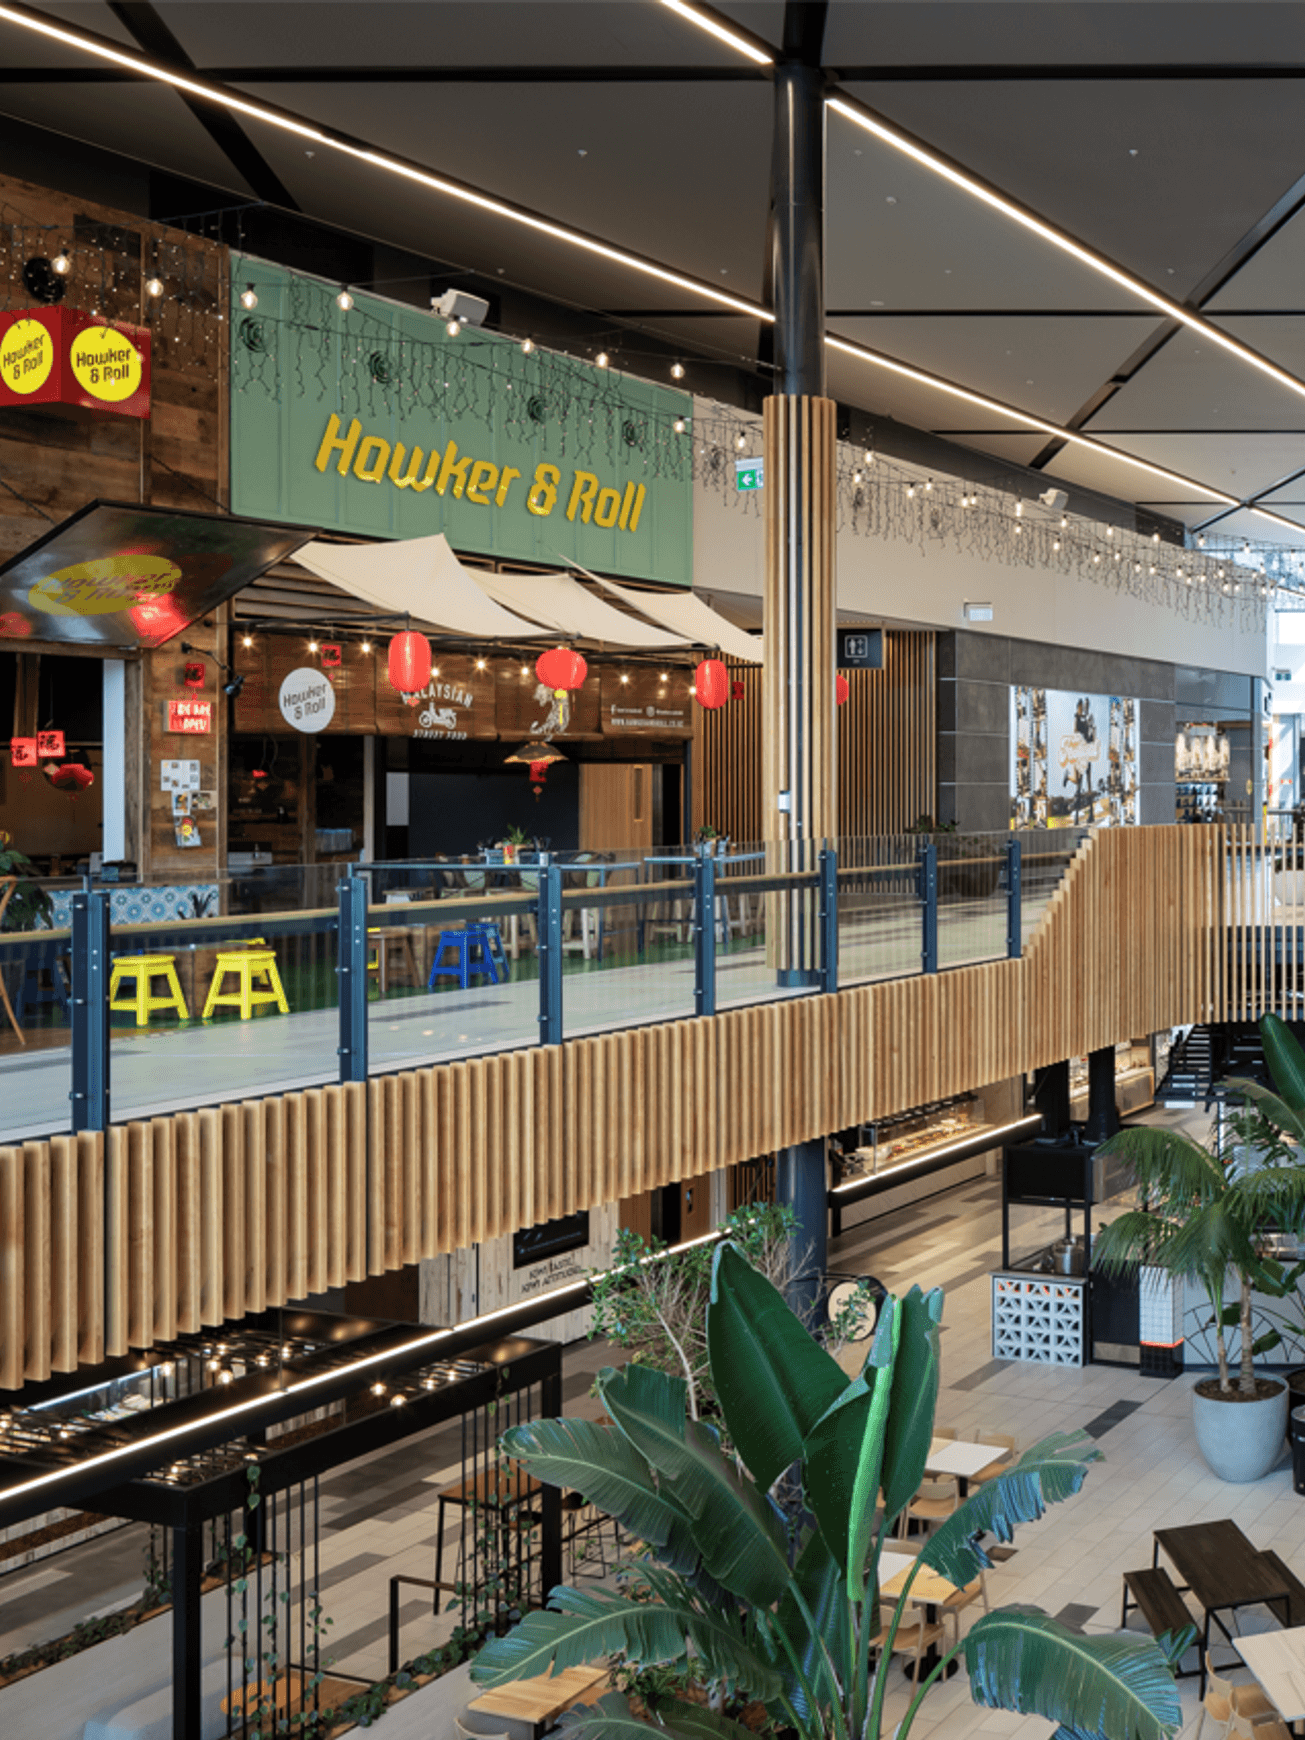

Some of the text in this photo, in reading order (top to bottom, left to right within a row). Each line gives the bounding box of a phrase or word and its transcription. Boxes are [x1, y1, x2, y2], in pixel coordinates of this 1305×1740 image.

[2, 333, 46, 368] Hawker
[76, 347, 131, 368] Hawker
[13, 349, 44, 380] & Roll
[90, 363, 130, 384] & Roll
[314, 412, 646, 533] Hawker & Roll
[283, 683, 327, 708] Hawker
[294, 698, 326, 720] & Roll
